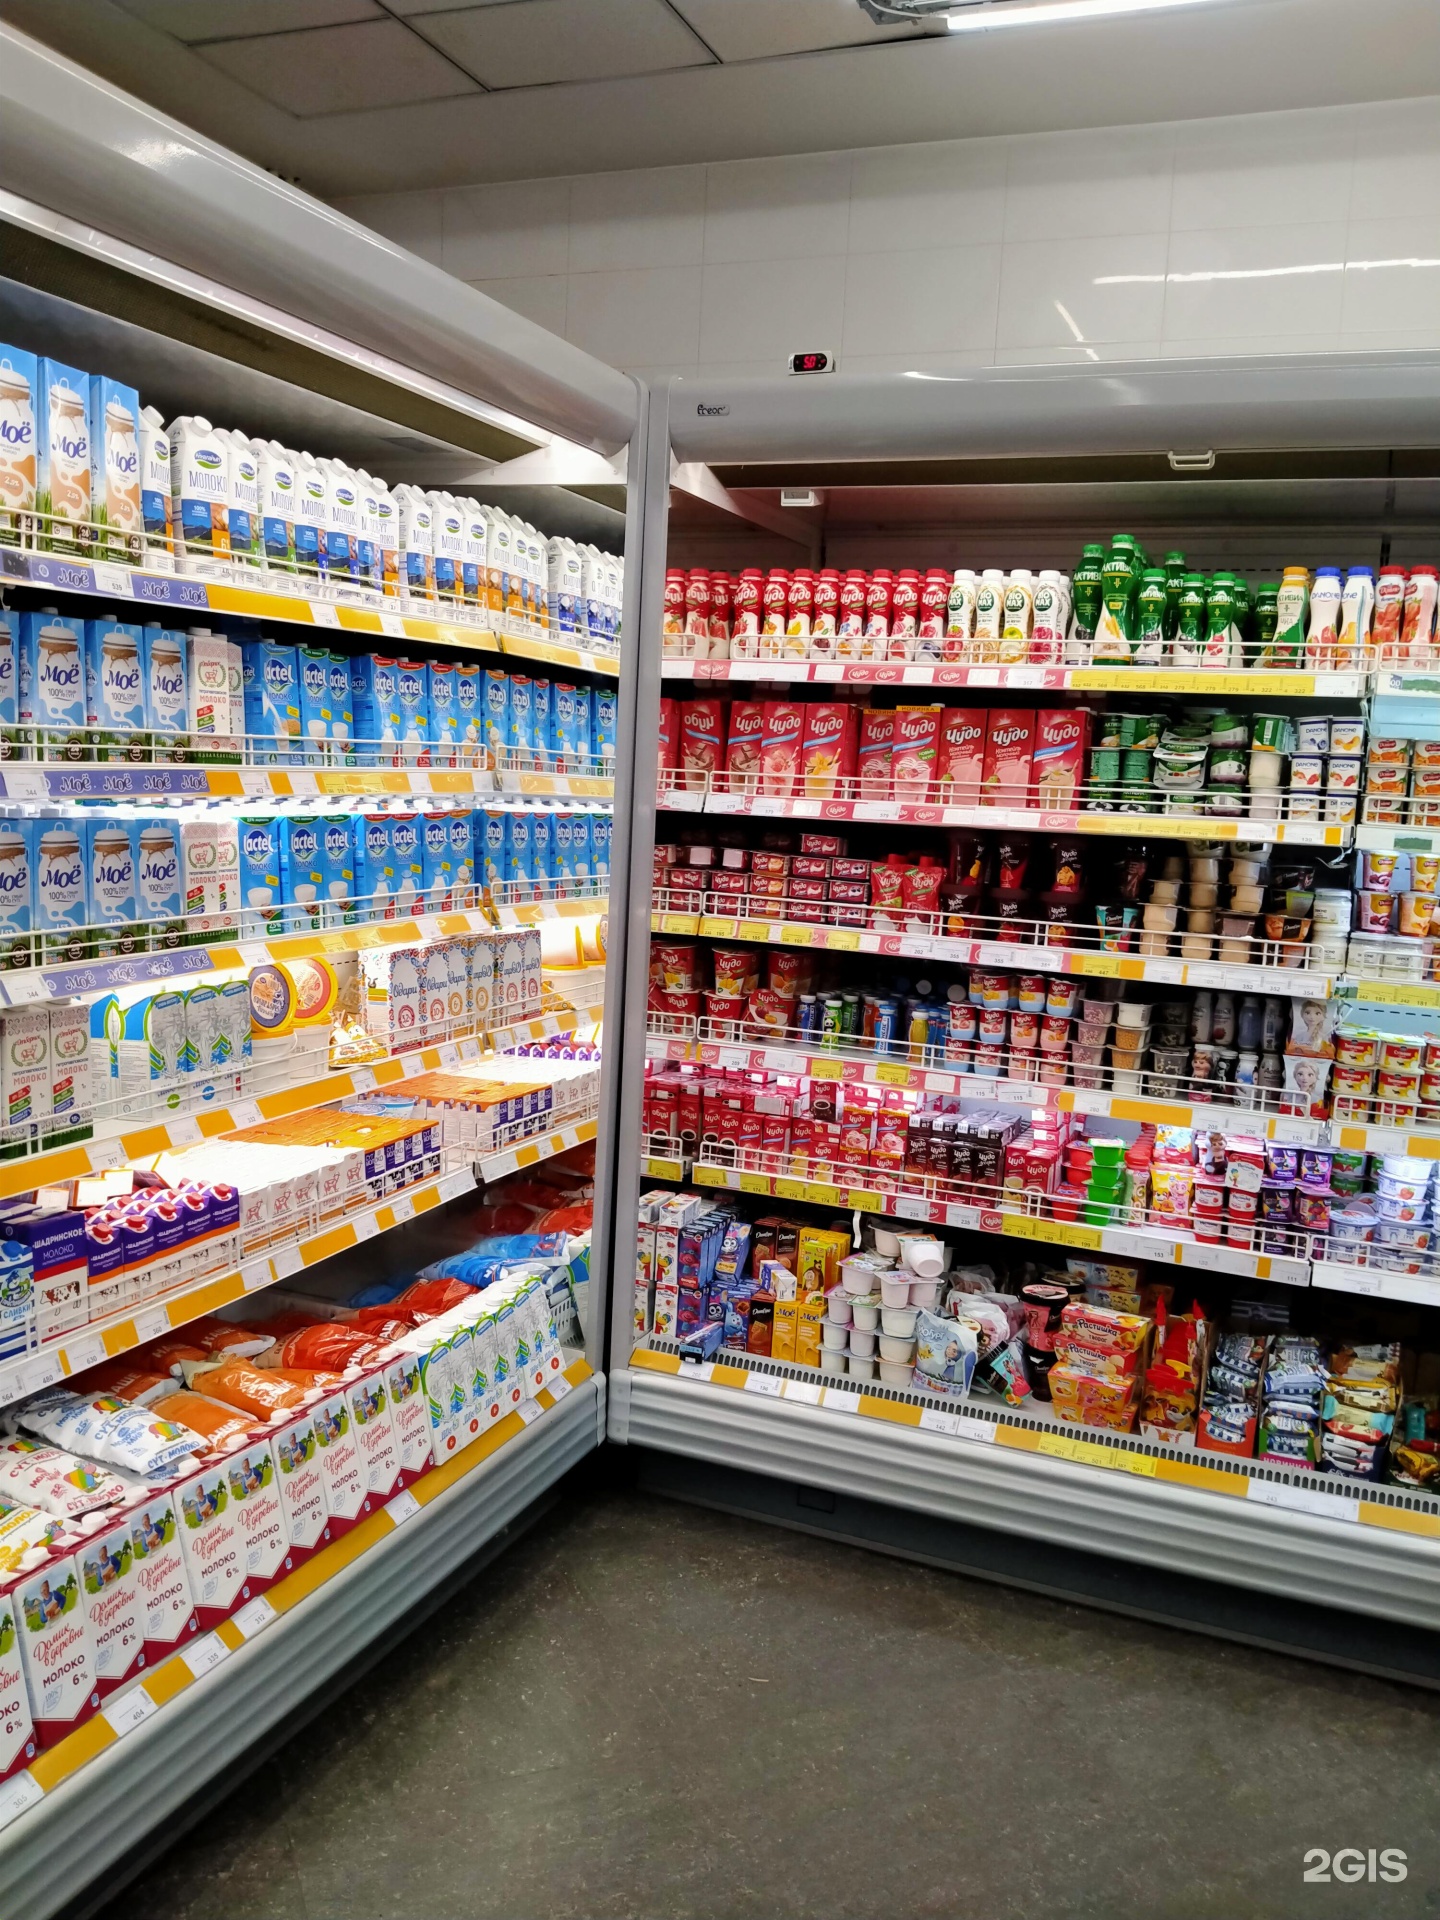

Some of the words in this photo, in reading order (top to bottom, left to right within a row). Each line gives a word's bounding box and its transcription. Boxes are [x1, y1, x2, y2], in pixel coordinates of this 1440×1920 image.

[52, 436, 87, 458] Моё
[107, 452, 137, 472] Моё
[58, 570, 89, 587] Моё
[142, 581, 170, 598] Моё
[180, 587, 206, 603] Моё
[41, 664, 79, 685] Моё
[105, 669, 140, 689] Моё
[265, 659, 296, 683] lactel
[304, 667, 327, 687] lactel
[153, 675, 183, 694] Моё
[330, 672, 349, 690] lactel
[374, 671, 396, 693] lactel
[200, 696, 226, 704] МОЛОКО
[432, 682, 453, 702] lactel
[458, 684, 477, 701] lactel
[769, 717, 800, 733] Чудо
[811, 718, 843, 735] Чудо
[902, 720, 935, 738] Чудо
[1043, 724, 1080, 743] Чудо
[947, 726, 981, 744] Чудо
[993, 729, 1028, 746] Чудо
[61, 774, 91, 793] Моё
[104, 774, 132, 792] Моё
[144, 773, 171, 791] Моё
[181, 772, 207, 788] Моё
[291, 833, 318, 851] lactel
[325, 831, 351, 849] lactel
[366, 830, 391, 847] lactel
[392, 829, 417, 846] lactel
[426, 829, 448, 844] lactel
[451, 826, 472, 841] lactel
[244, 834, 273, 854] lactel
[41, 864, 81, 888] Моё
[96, 861, 131, 883] Моё
[142, 859, 176, 880] Моё
[190, 876, 216, 884] МОЛОКО
[183, 954, 209, 969] Моё
[719, 958, 741, 970] Чудо
[67, 971, 96, 989] Моё
[709, 1001, 730, 1012] Чудо
[758, 993, 778, 1003] Чудо
[14, 1073, 47, 1086] МОЛОКО
[57, 1064, 88, 1077] МОЛОКО
[722, 1118, 739, 1128] Чудо
[743, 1123, 760, 1133] Чудо
[849, 1115, 865, 1123] Чудо
[884, 1118, 901, 1126] Чудо
[766, 1127, 784, 1135] Чудо
[1028, 1165, 1047, 1176] Чудо
[43, 1244, 74, 1260] МОЛОКО
[3, 1303, 31, 1319] СЛИВКИ
[777, 1308, 796, 1319] Моё
[800, 1313, 819, 1321] Моё
[1077, 1319, 1117, 1337] Растишка
[87, 1355, 97, 1365] 630
[1068, 1343, 1106, 1361] Растишка
[43, 1375, 53, 1384] 480
[396, 1404, 418, 1426] Домик
[406, 1405, 424, 1430] деревне
[361, 1422, 383, 1446] Домик
[371, 1425, 391, 1450] деревне
[402, 1425, 425, 1445] МОЛОКО
[323, 1444, 346, 1471] Домик
[335, 1447, 356, 1474] деревне
[367, 1447, 392, 1468] МОЛОКО
[285, 1470, 310, 1498] Домик
[297, 1473, 320, 1502] деревне
[332, 1469, 358, 1491] МОЛОКО
[238, 1496, 267, 1525] Домик
[252, 1499, 279, 1530] деревне
[292, 1496, 321, 1520] МОЛОКО
[193, 1523, 222, 1552] Домик
[206, 1526, 235, 1556] деревне
[246, 1524, 280, 1549] МОЛОКО
[138, 1553, 169, 1585] Домик
[152, 1557, 181, 1590] деревне
[201, 1552, 236, 1578] МОЛОКО
[90, 1587, 123, 1622] Домик
[147, 1582, 183, 1611] МОЛОКО
[104, 1590, 136, 1624] деревне
[34, 1621, 70, 1661] Домик
[96, 1617, 135, 1647] МОЛОКО
[50, 1626, 84, 1666] деревне
[43, 1655, 85, 1688] МОЛОКО
[133, 1709, 144, 1721] 404
